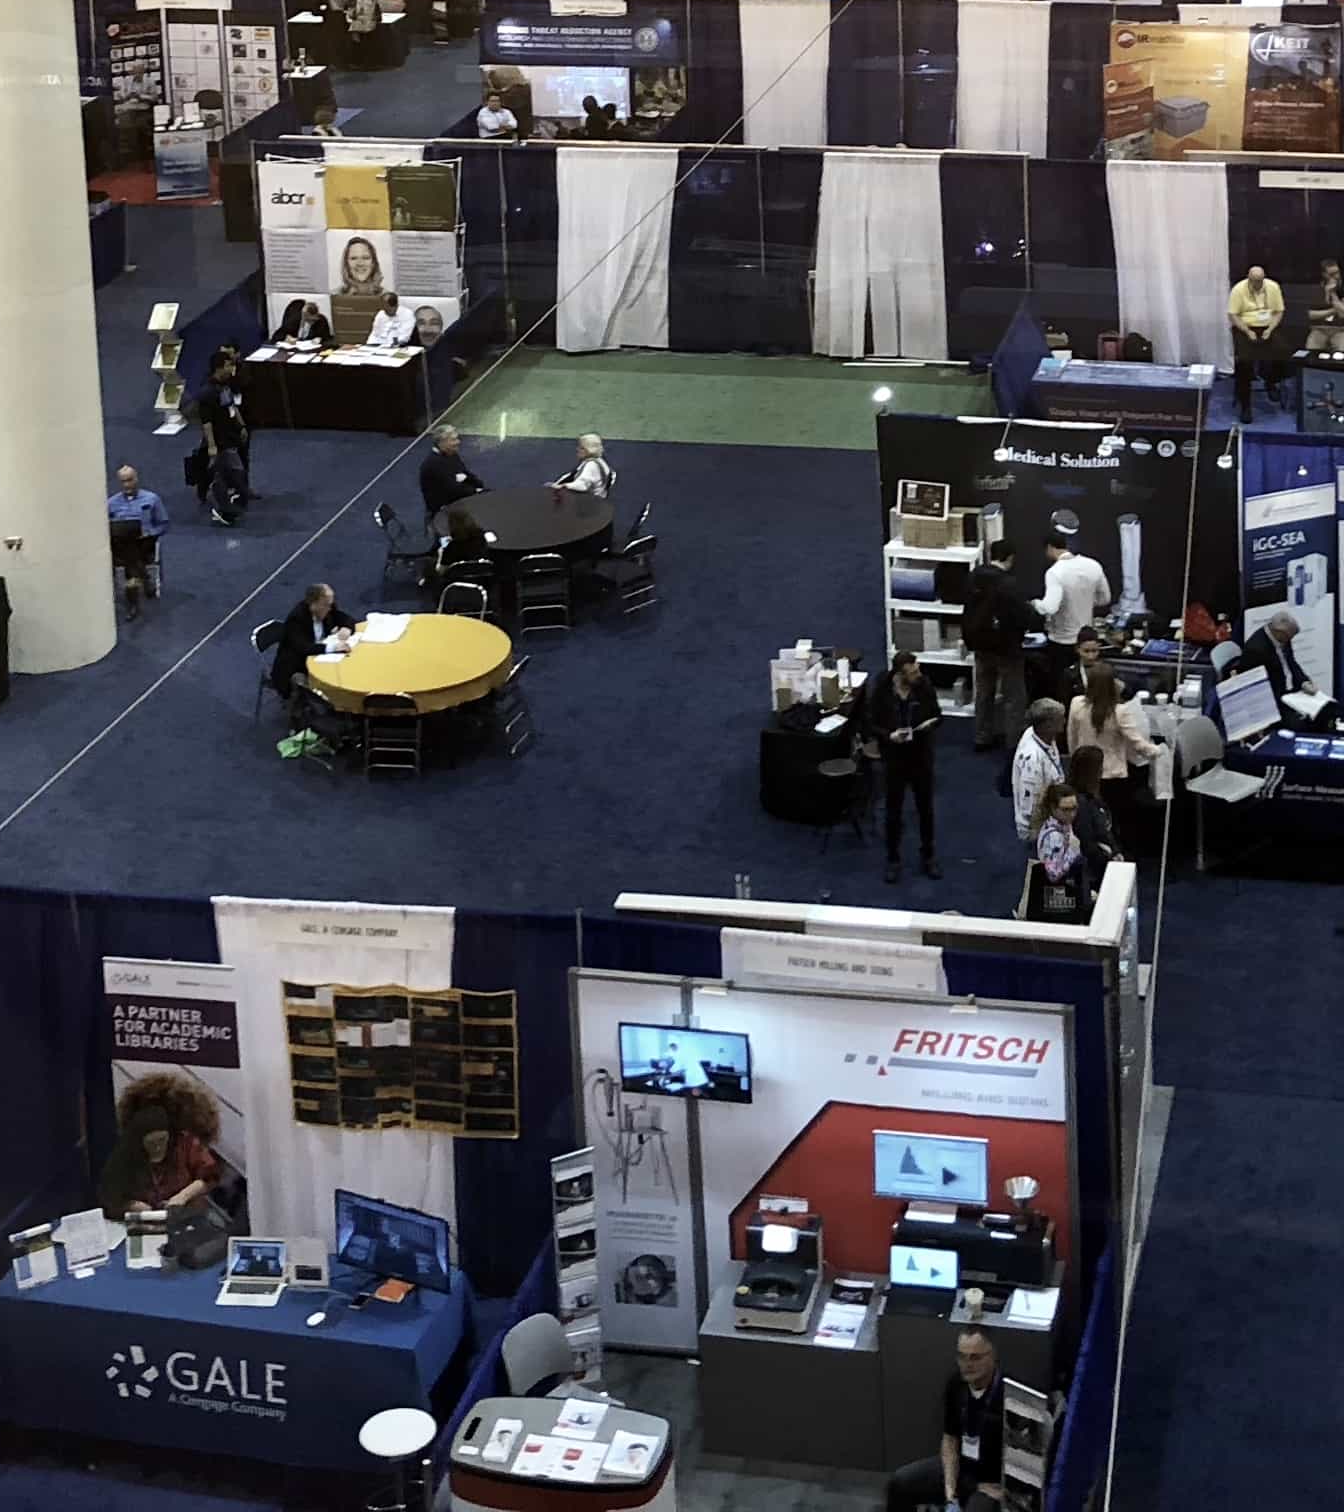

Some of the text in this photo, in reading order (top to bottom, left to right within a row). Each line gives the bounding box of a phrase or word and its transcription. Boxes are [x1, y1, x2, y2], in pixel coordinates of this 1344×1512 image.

[603, 27, 633, 36] AGENCY
[1273, 37, 1310, 50] KEIT
[271, 187, 305, 204] abcr
[1060, 452, 1120, 469] Solution
[113, 1005, 202, 1023] A PARTNER
[114, 1019, 232, 1041] FOR ACADEMIC
[115, 1033, 200, 1052] LIBRARIES
[892, 1028, 1051, 1065] FRITSCH
[165, 1351, 288, 1405] GALE
[167, 1391, 287, 1424] A Cengage Company
